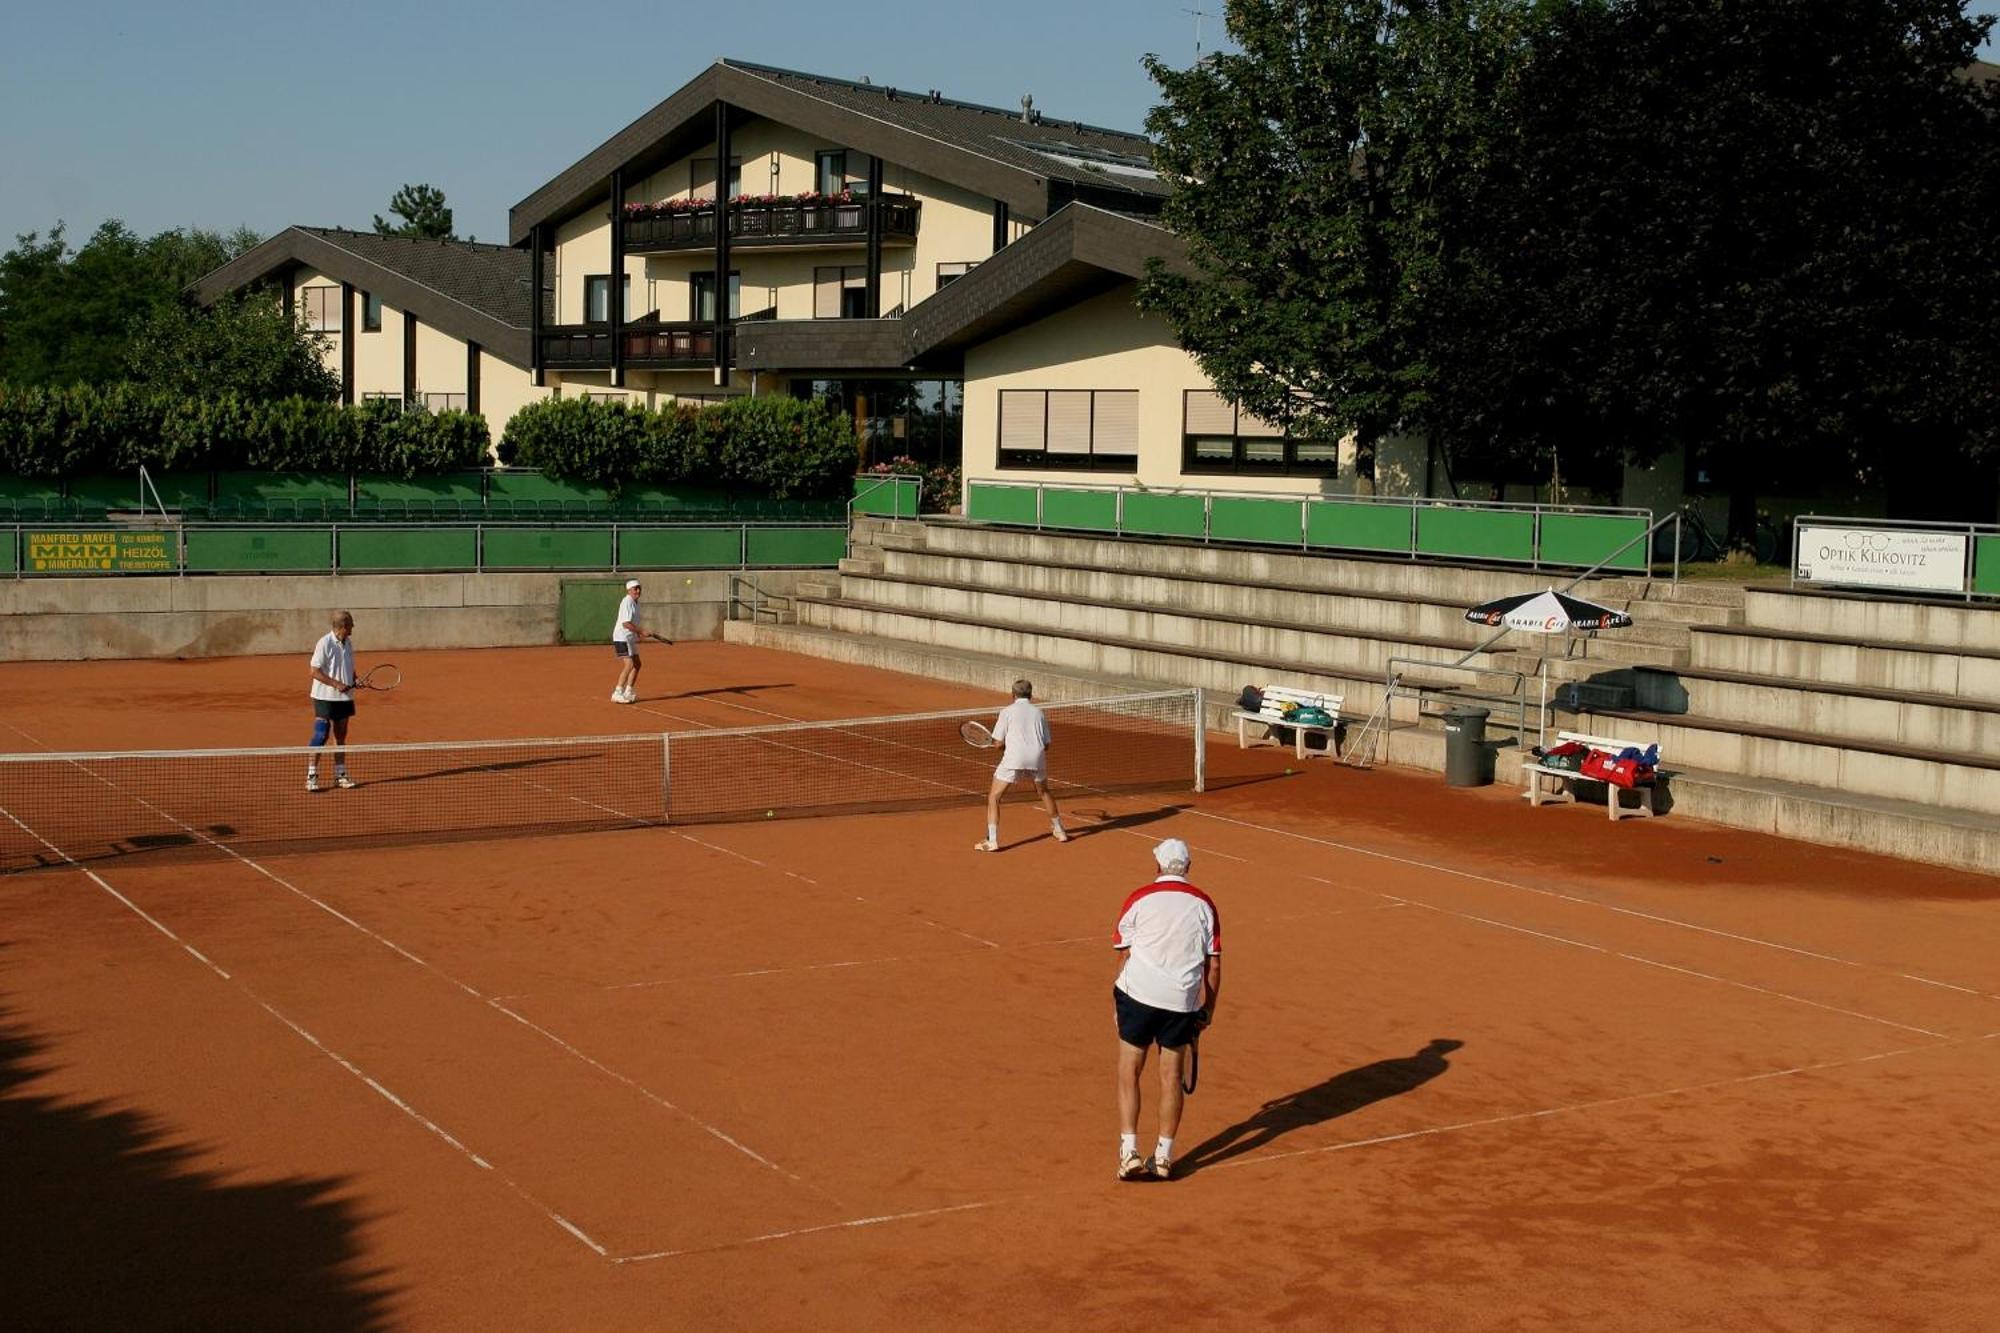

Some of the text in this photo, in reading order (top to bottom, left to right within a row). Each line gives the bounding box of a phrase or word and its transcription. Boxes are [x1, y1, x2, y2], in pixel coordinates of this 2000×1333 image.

[31, 534, 79, 544] MANFRED
[82, 534, 115, 544] MAYER
[36, 545, 111, 557] MMM
[122, 546, 168, 558] HEIZÖL
